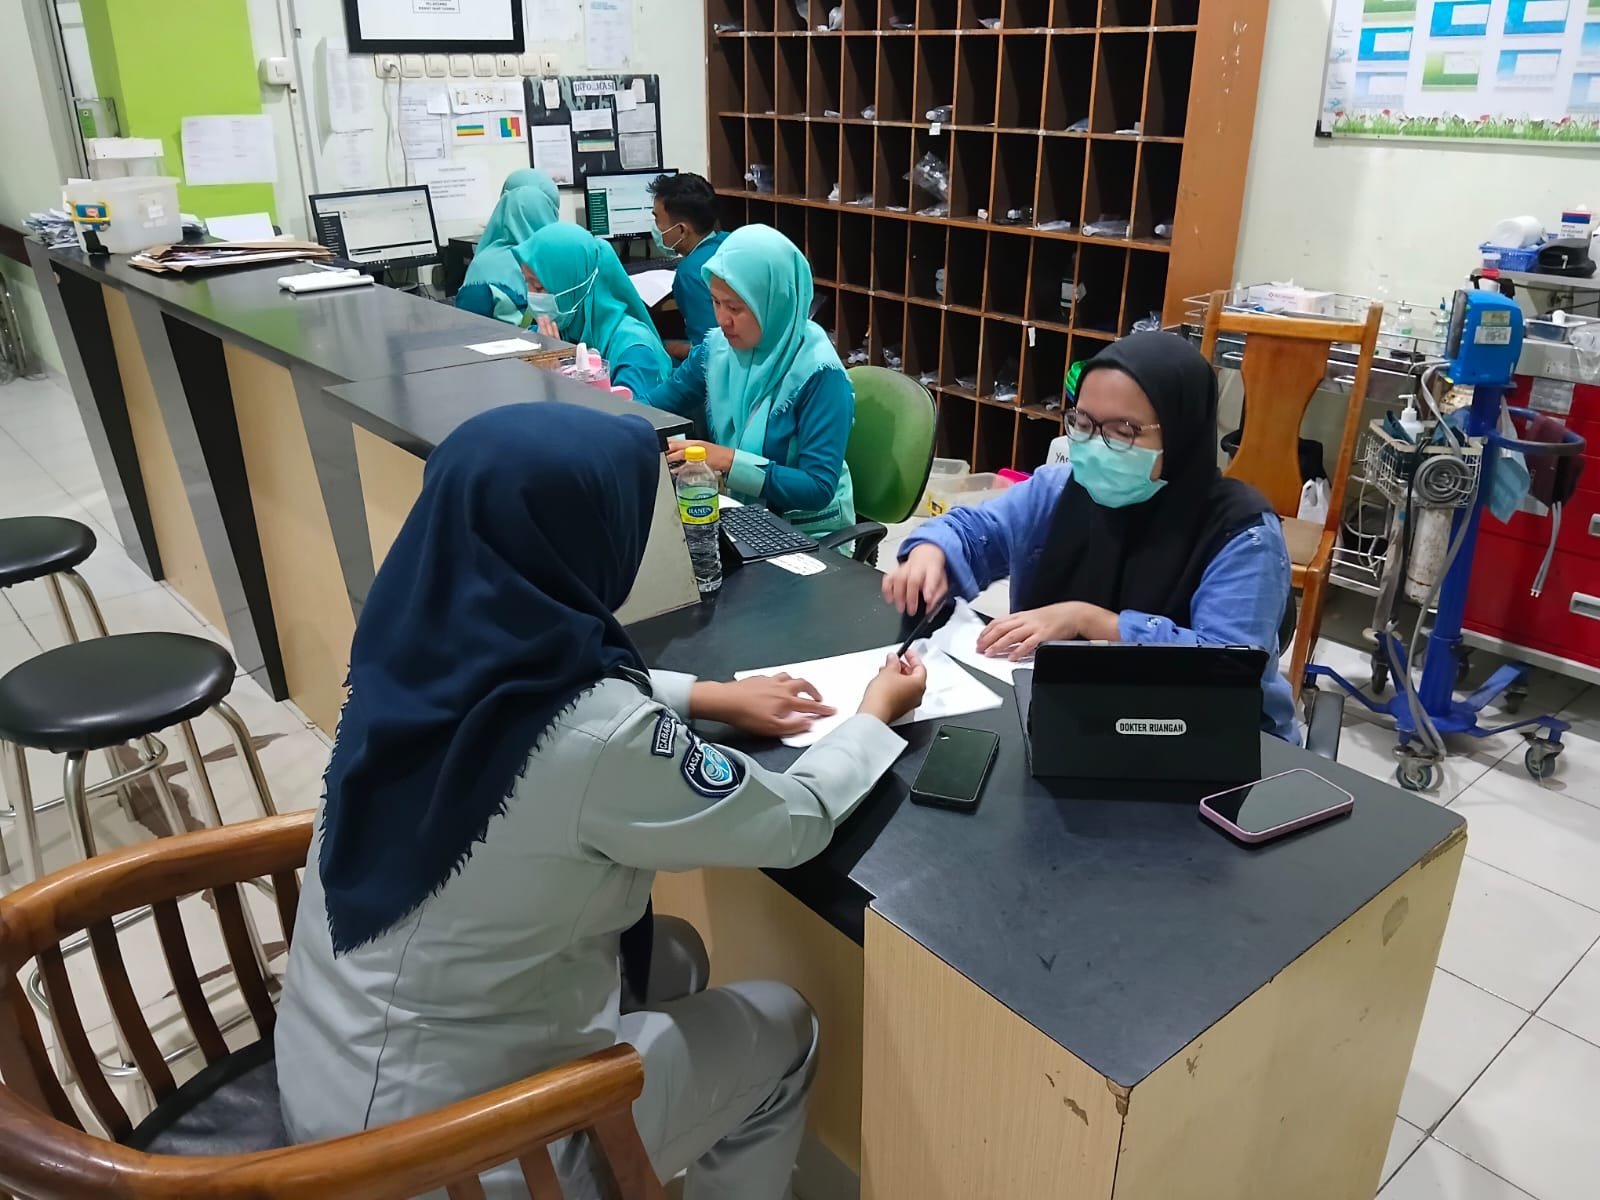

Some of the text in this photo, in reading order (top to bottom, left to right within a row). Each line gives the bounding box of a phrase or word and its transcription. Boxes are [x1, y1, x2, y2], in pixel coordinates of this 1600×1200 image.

[1119, 723, 1183, 733] DOKTER RUANGAN
[687, 752, 702, 775] JASA
